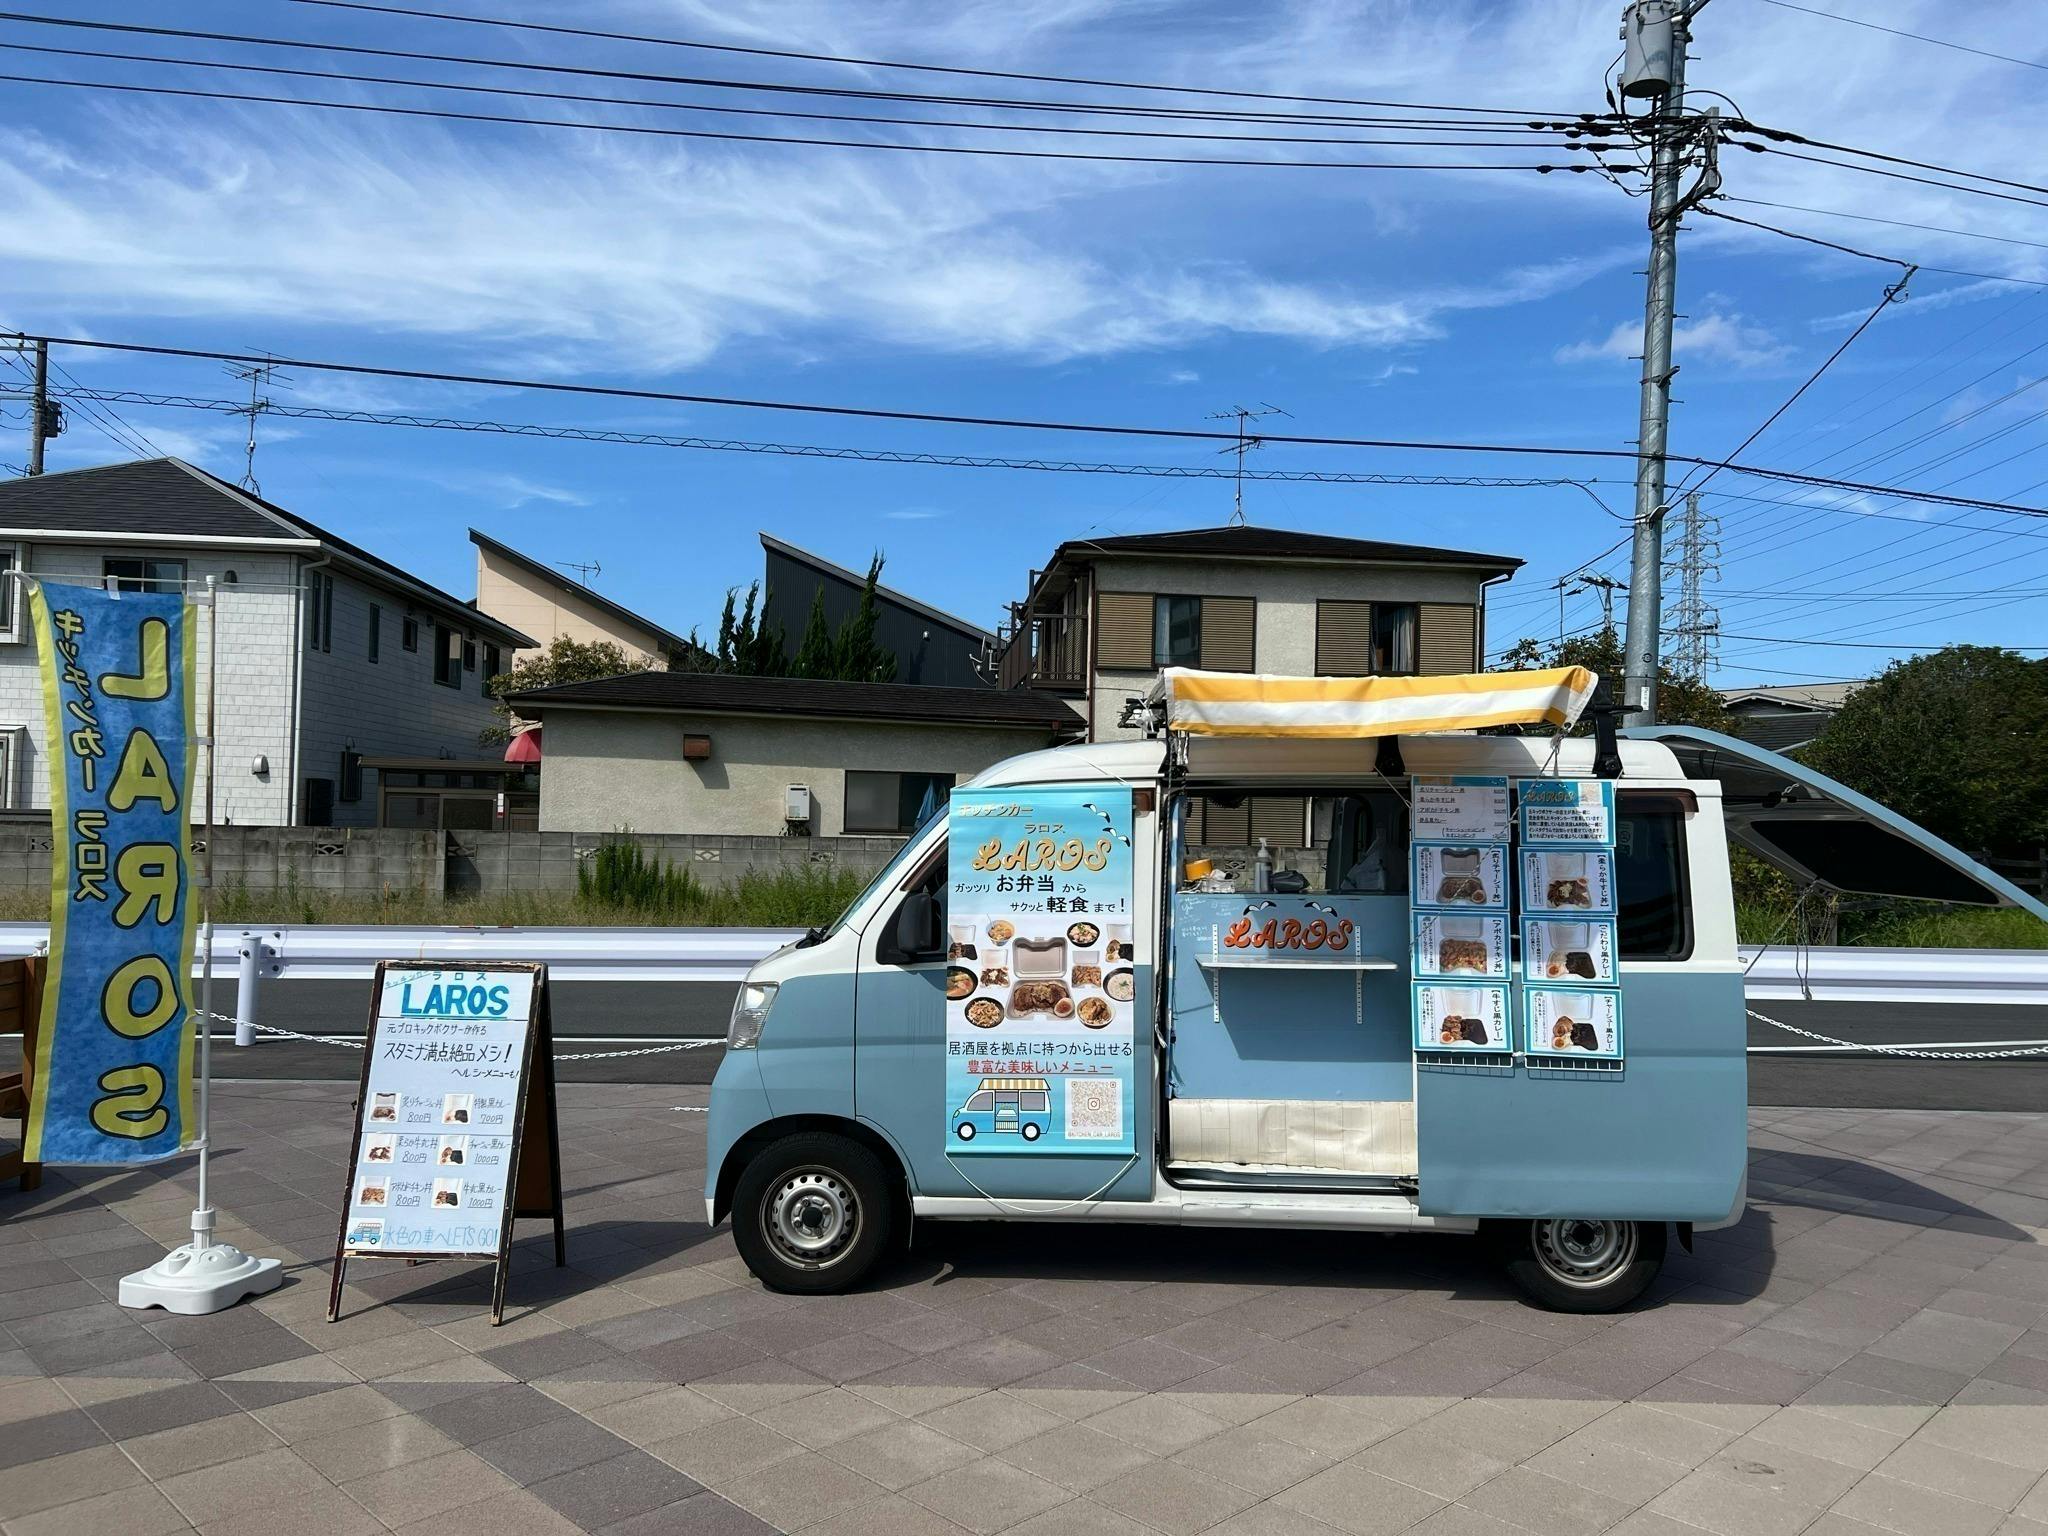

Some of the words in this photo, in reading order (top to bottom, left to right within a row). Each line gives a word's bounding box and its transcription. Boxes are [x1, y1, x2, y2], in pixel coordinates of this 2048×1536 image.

[1024, 824, 1065, 834] ラロス
[972, 838, 1112, 872] LAROS
[955, 883, 990, 893] ガッツリ
[996, 874, 1054, 892] お弁当
[1062, 883, 1087, 893] から
[1046, 896, 1089, 913] 軽食
[1223, 917, 1353, 951] LAROS
[401, 983, 510, 1015] LAROS
[948, 1041, 1132, 1056] 居酒屋を拠点に持つから出せる
[967, 1059, 1113, 1073] 豊富な美味しいメニュー
[407, 1111, 431, 1122] 800円
[402, 1151, 427, 1162] 800円
[396, 1194, 421, 1206] 800円
